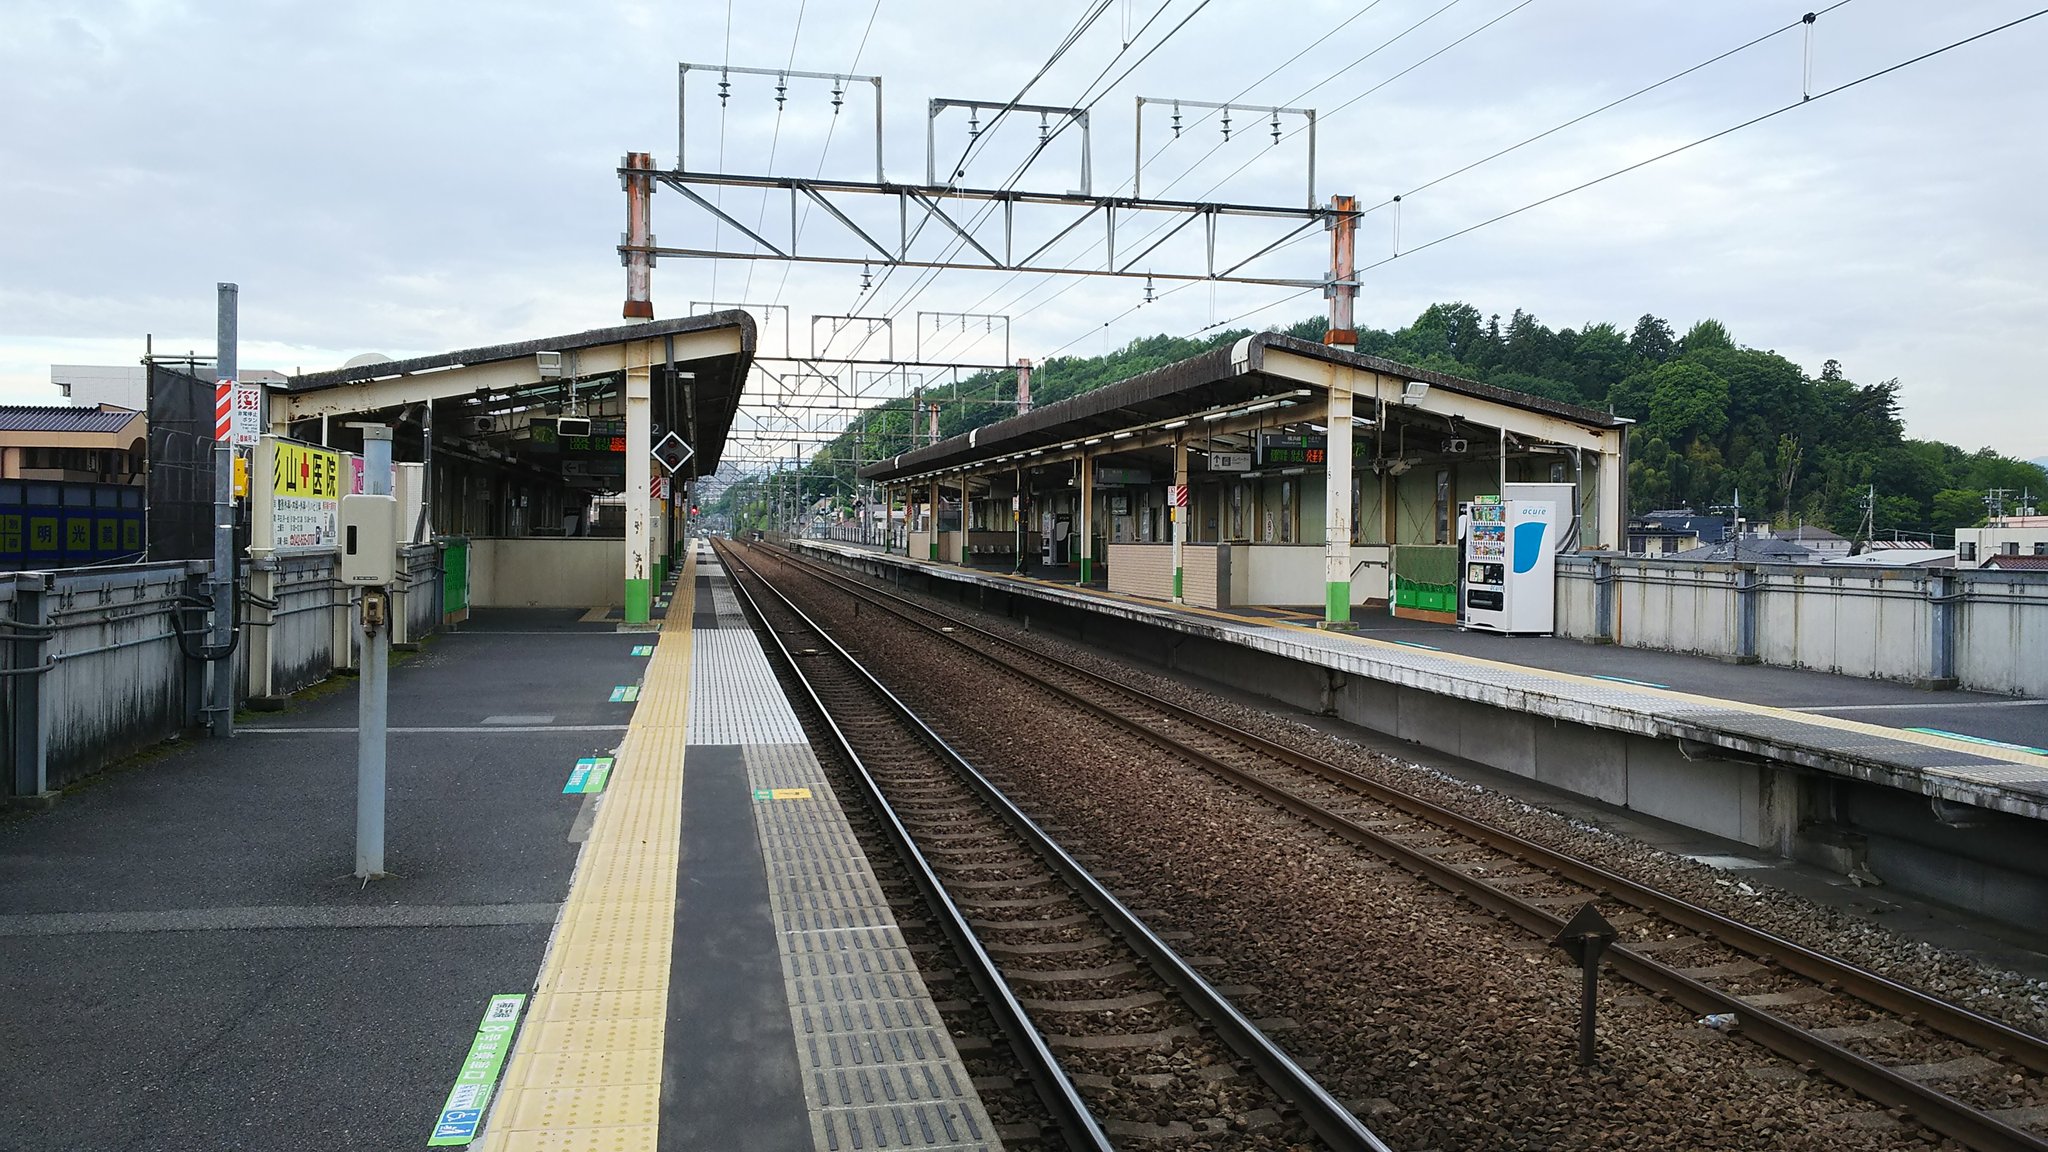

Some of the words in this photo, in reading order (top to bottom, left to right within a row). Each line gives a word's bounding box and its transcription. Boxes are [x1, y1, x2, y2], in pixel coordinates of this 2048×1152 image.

[651, 424, 659, 434] 2
[1265, 435, 1271, 446] 1
[312, 453, 336, 498] 医院
